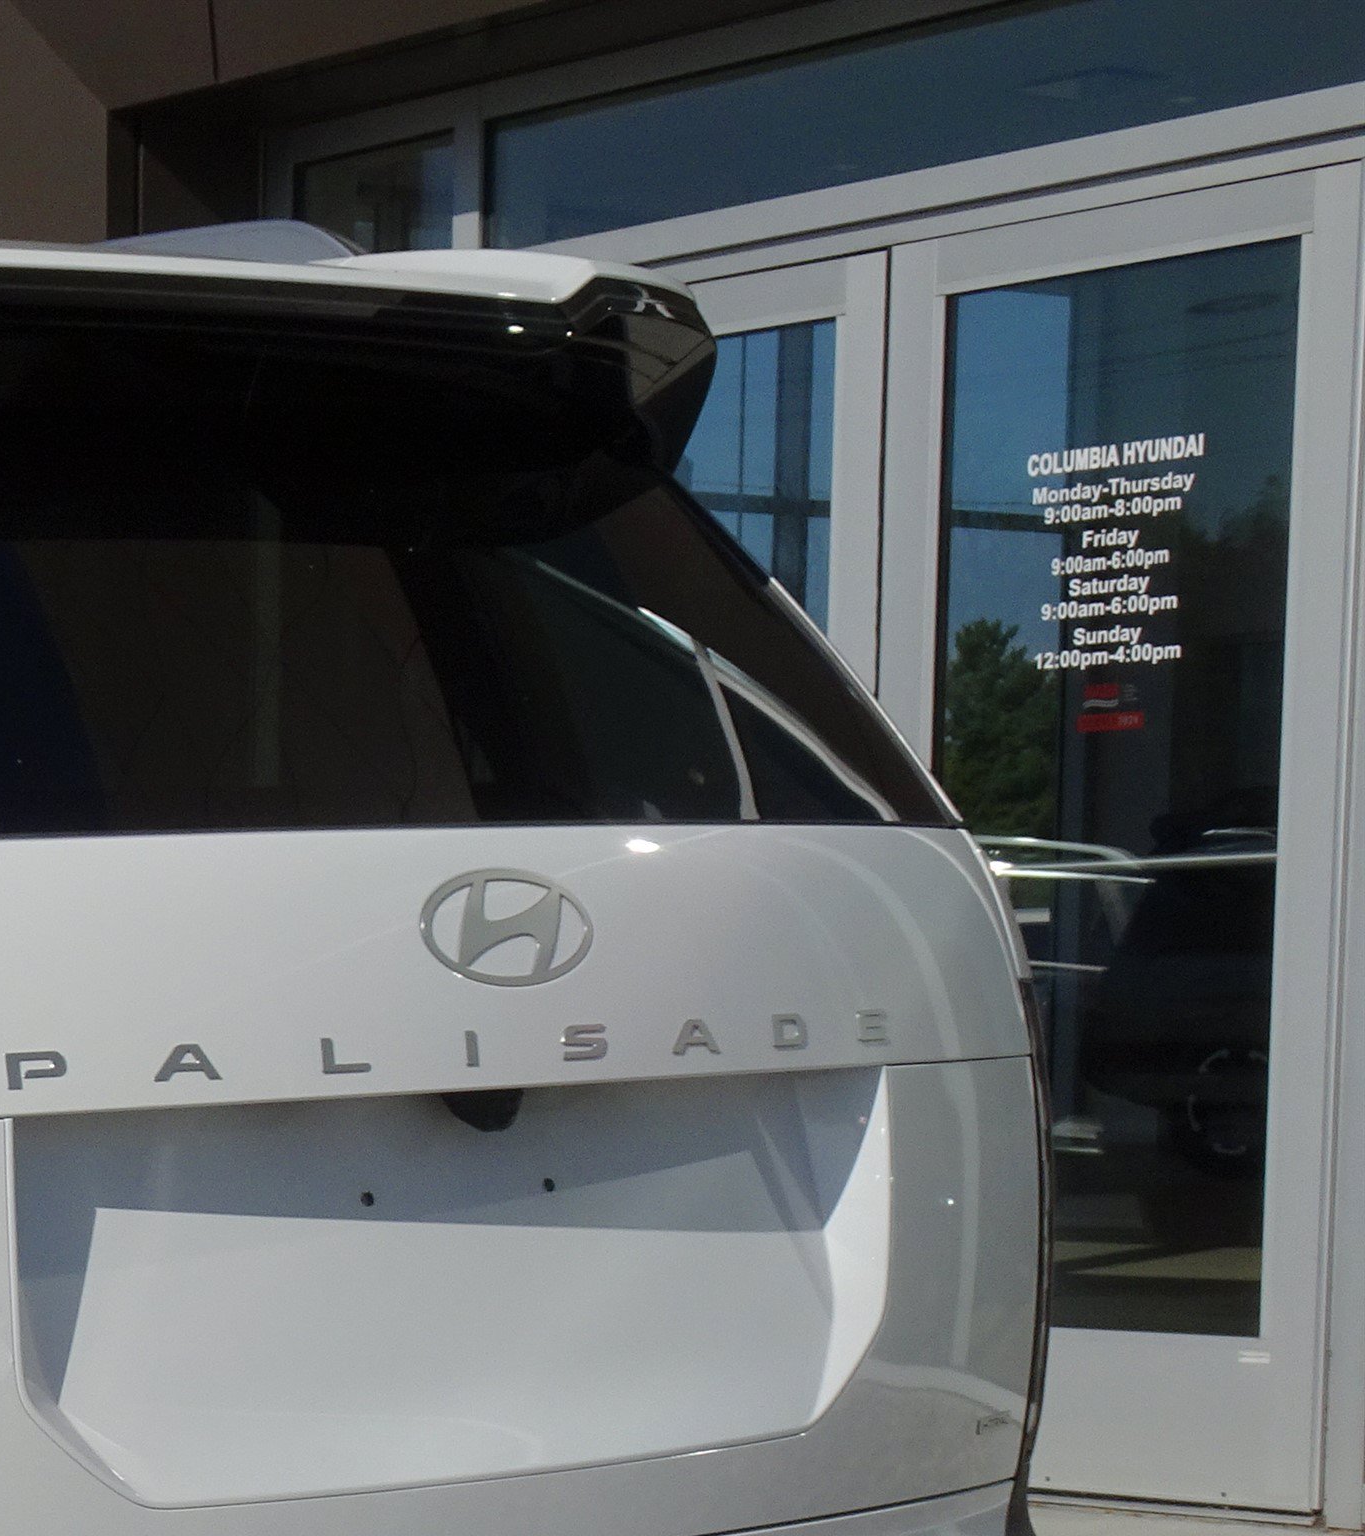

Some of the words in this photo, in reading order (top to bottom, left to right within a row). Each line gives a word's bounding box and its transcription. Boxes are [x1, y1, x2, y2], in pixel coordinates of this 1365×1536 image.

[1027, 444, 1119, 477] COLUMBIA
[1122, 432, 1205, 466] HYUNDAI
[1032, 471, 1195, 505] Monday-Thursday
[1044, 495, 1182, 525] 9:00am-8:00pm
[1081, 527, 1140, 549] Friday
[1050, 548, 1170, 576] 9:00am-6:00pm
[1068, 574, 1150, 597] Saturday
[1040, 594, 1178, 621] 9:00am-6:00pm
[1072, 625, 1142, 646] Sunday
[1034, 643, 1182, 671] 12:00pm-4:00pm
[4, 1008, 889, 1091] PALISADE
